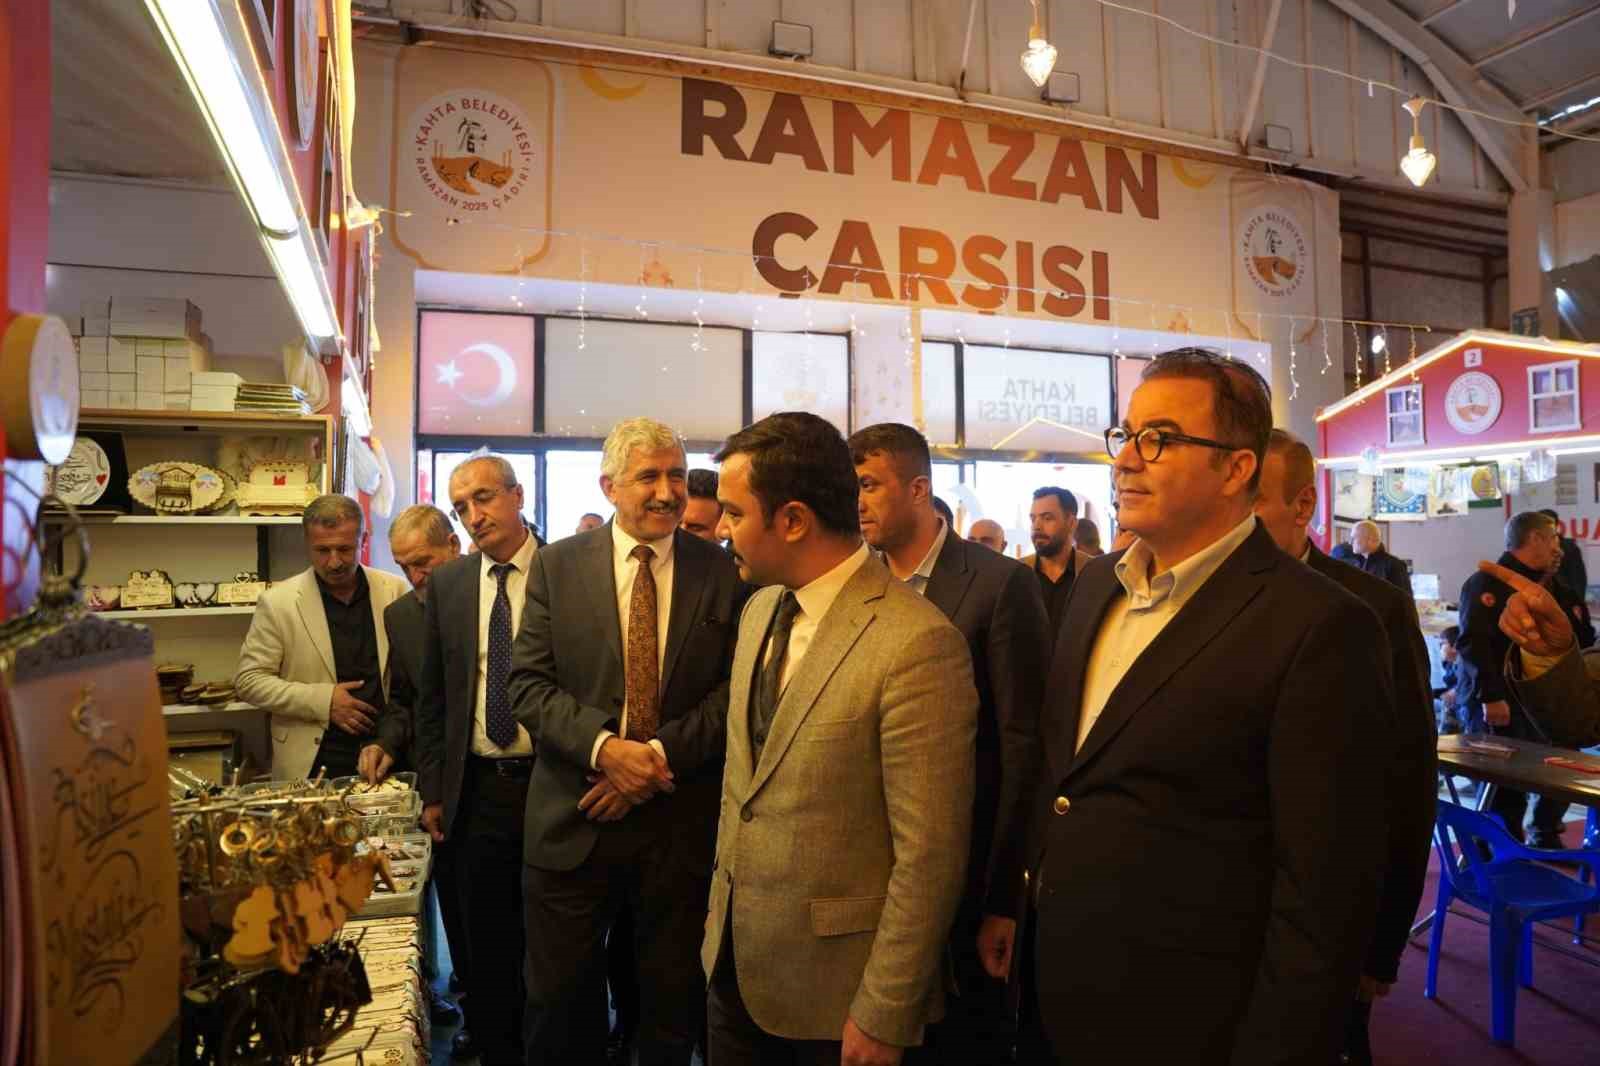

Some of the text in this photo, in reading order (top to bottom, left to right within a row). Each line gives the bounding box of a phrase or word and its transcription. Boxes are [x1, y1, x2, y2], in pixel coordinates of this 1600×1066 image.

[416, 101, 456, 145] KAHTA
[681, 77, 1159, 219] RAMAZAN
[416, 158, 458, 206] RAMAZAN
[462, 201, 488, 211] 2025
[752, 211, 1110, 321] ÇARŞISI
[1470, 353, 1477, 363] 2
